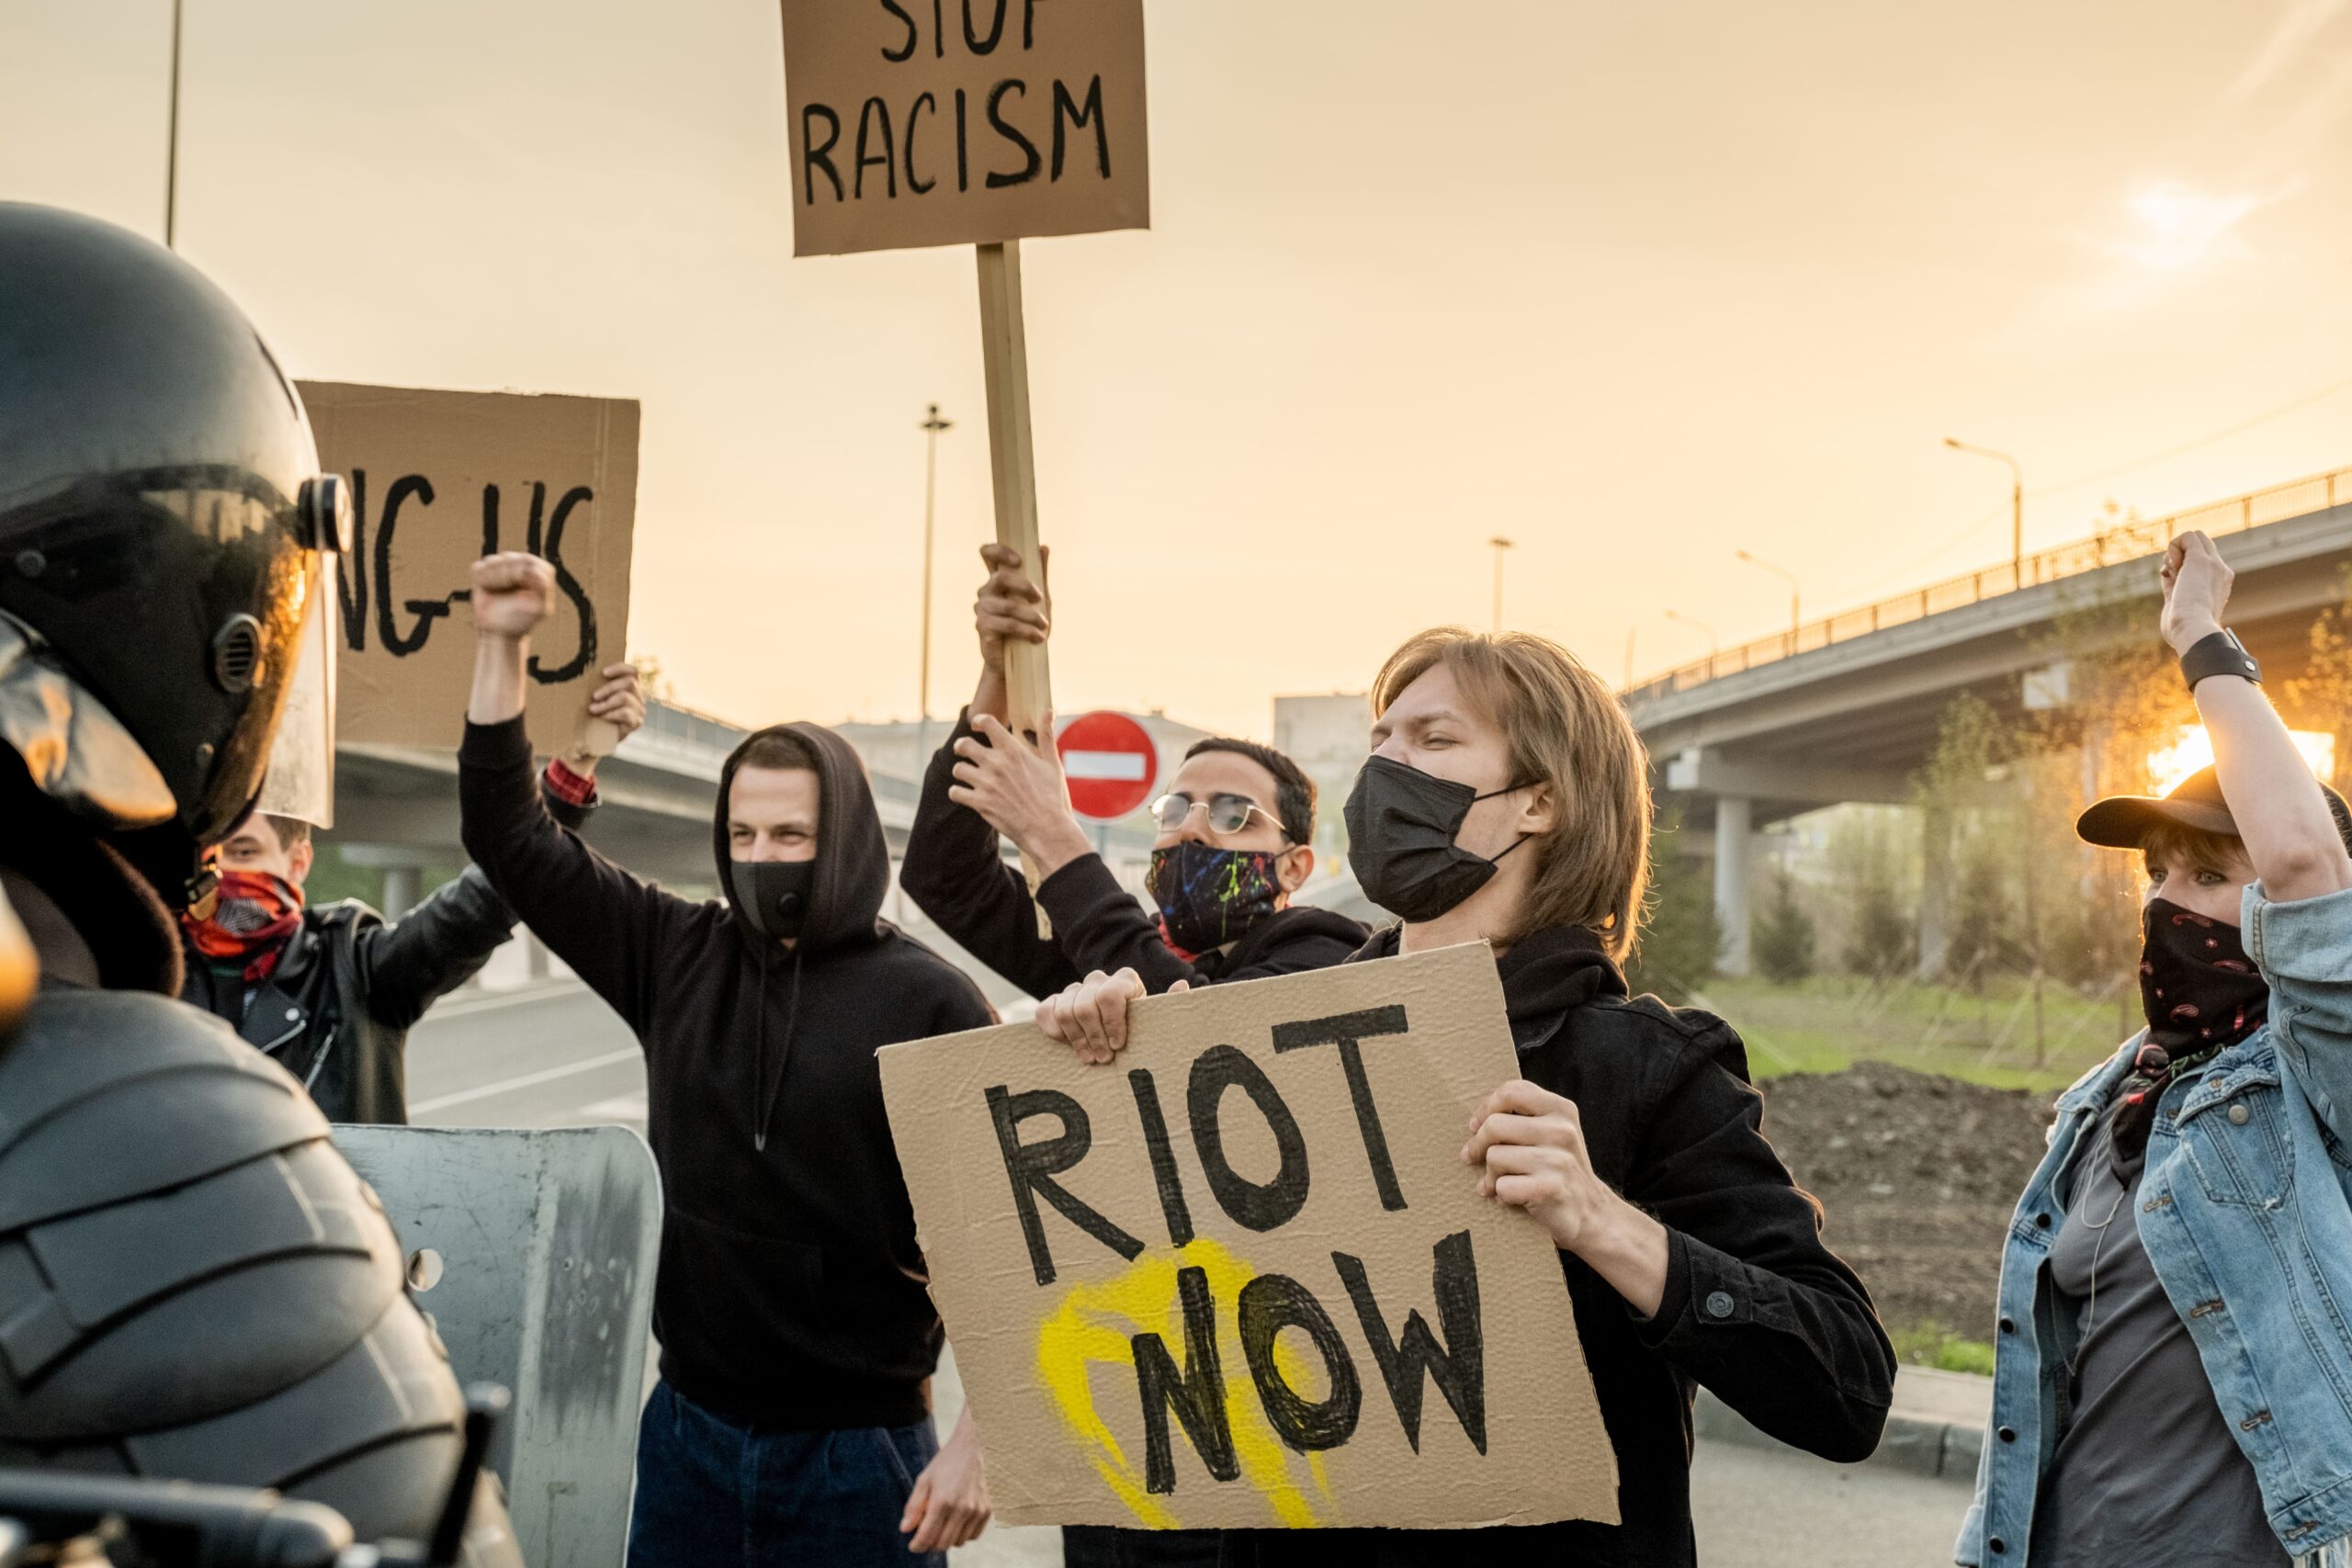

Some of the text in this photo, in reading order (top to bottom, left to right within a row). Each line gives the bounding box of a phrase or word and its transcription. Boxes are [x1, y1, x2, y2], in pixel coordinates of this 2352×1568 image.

[802, 73, 1111, 205] RACISM
[984, 1004, 1408, 1286] RIOT
[1130, 1229, 1487, 1495] NOW
